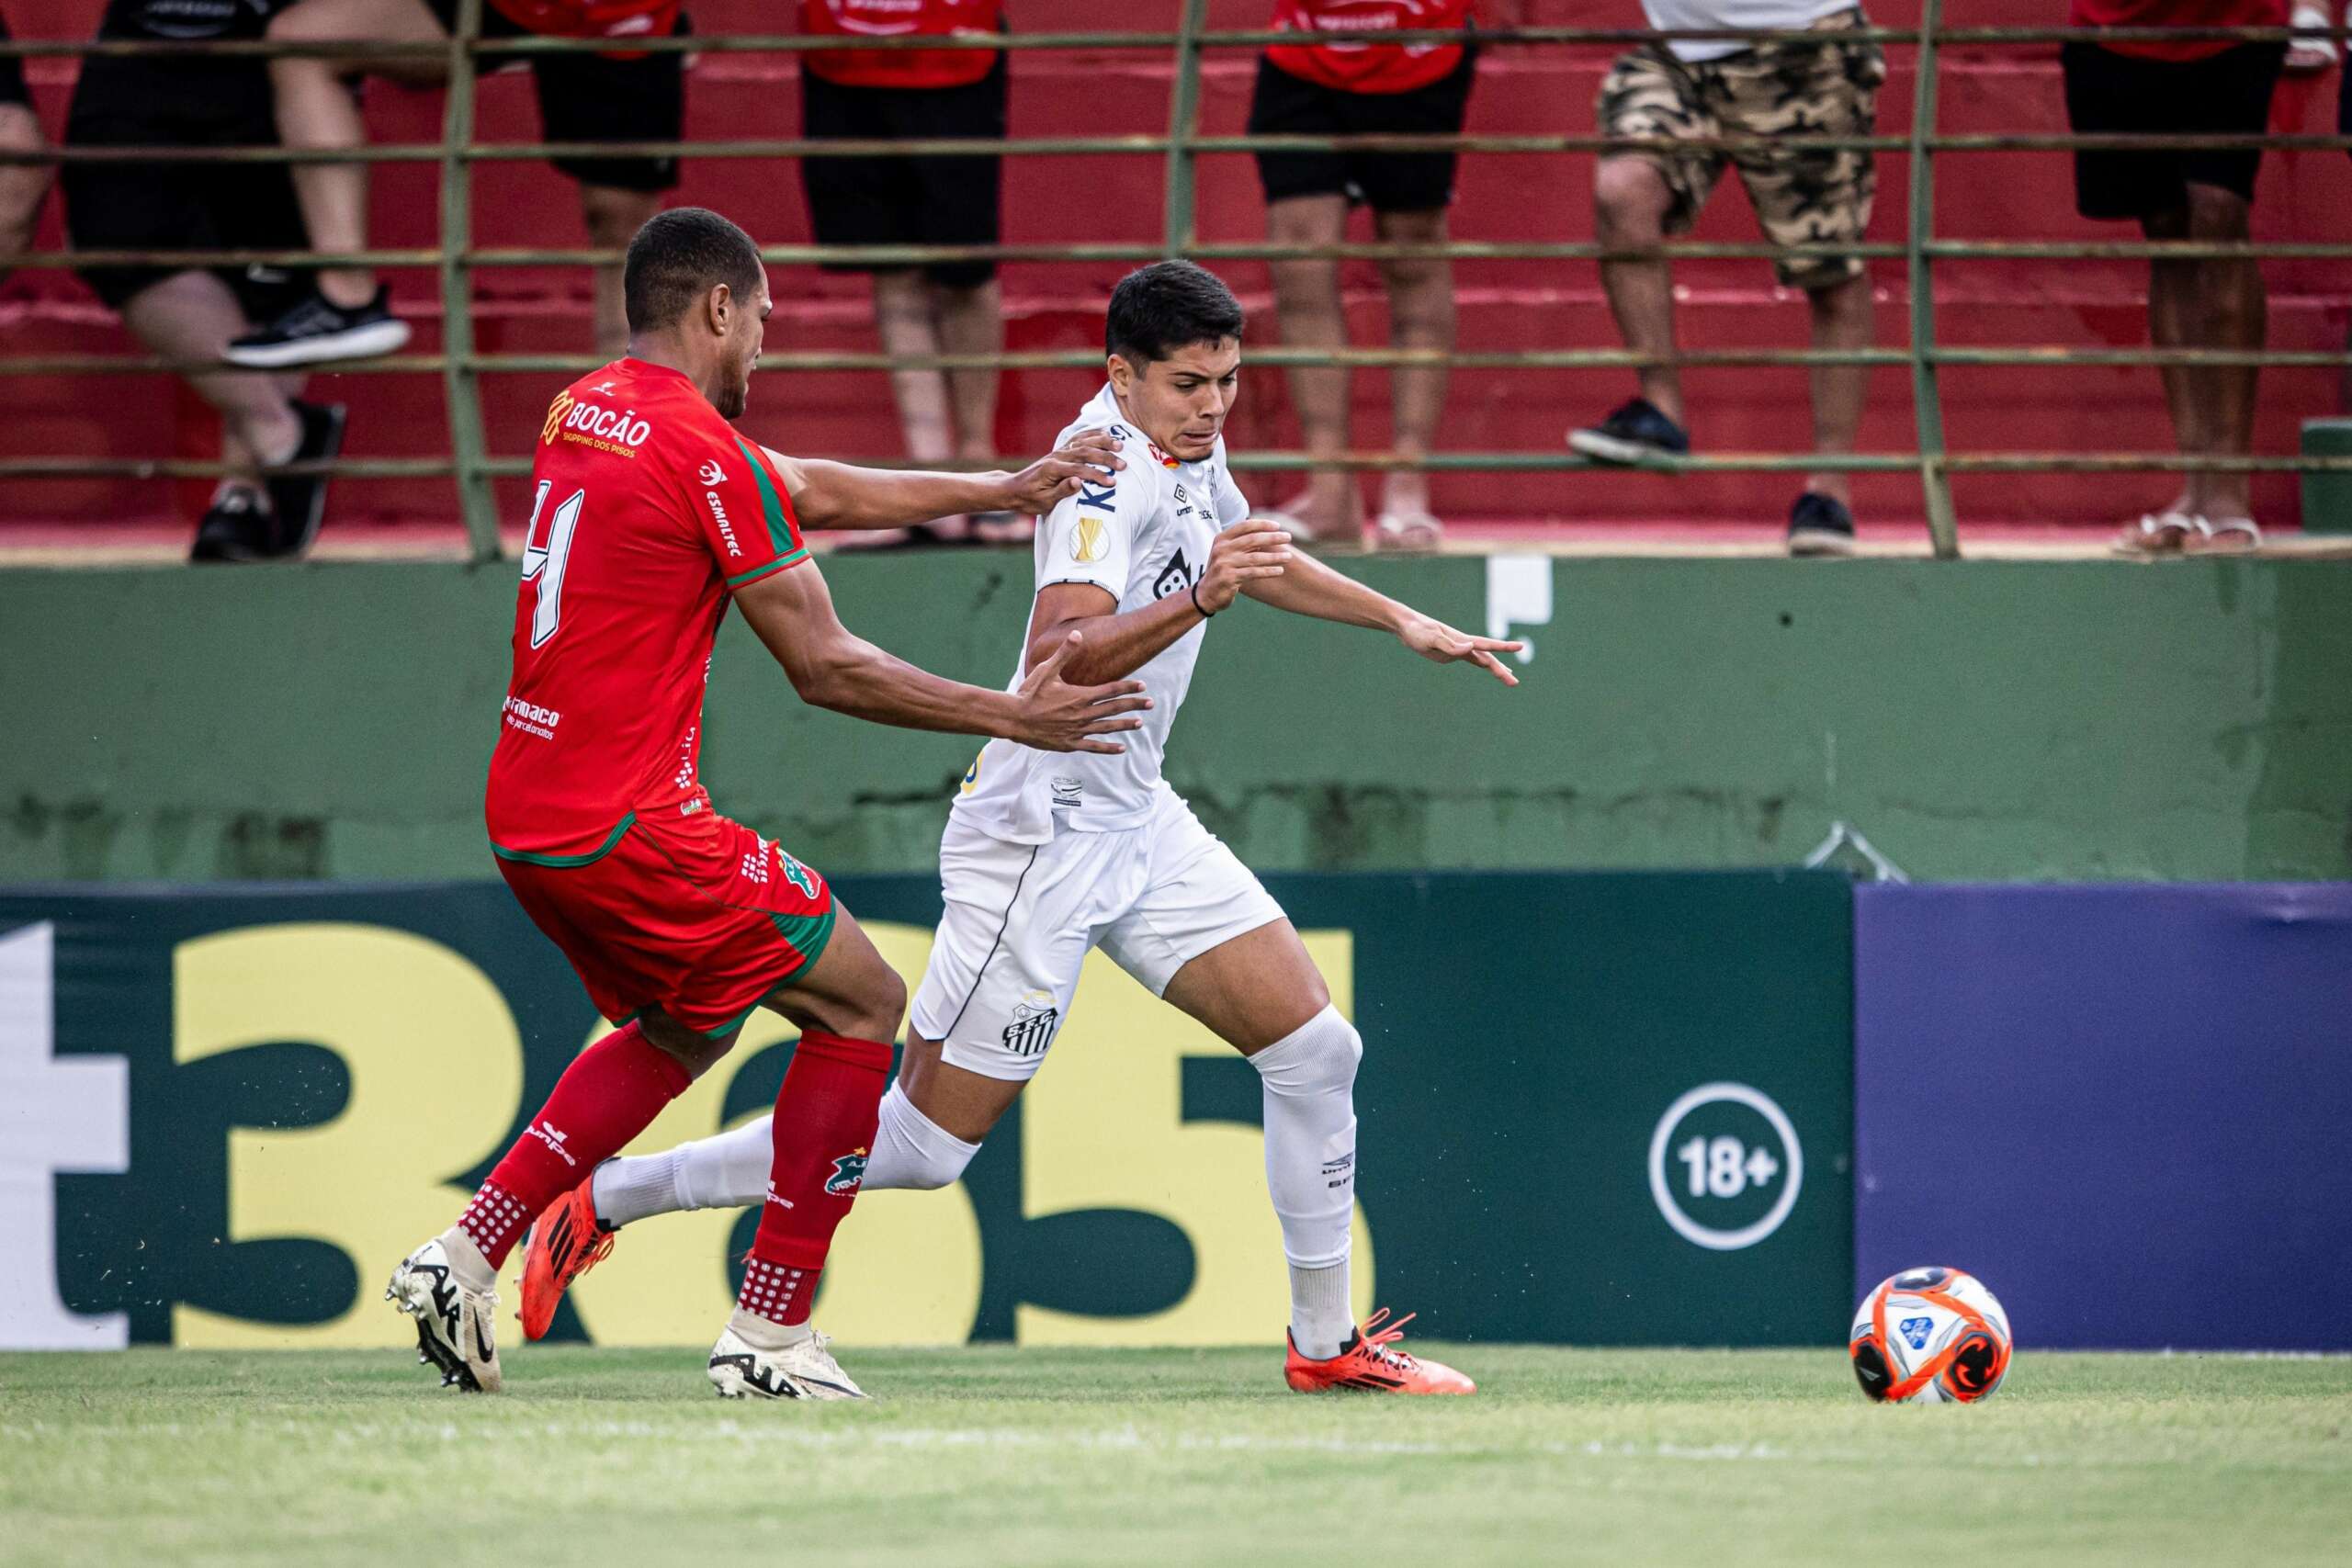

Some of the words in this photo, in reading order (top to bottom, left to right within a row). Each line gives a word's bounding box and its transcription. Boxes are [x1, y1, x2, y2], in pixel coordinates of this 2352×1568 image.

[566, 402, 650, 446] BOCÃO
[594, 439, 611, 451] DOS
[611, 444, 636, 458] PISOS
[706, 491, 742, 558] ESMALTEC
[521, 479, 584, 649] 4
[1677, 1135, 1779, 1198] 18+
